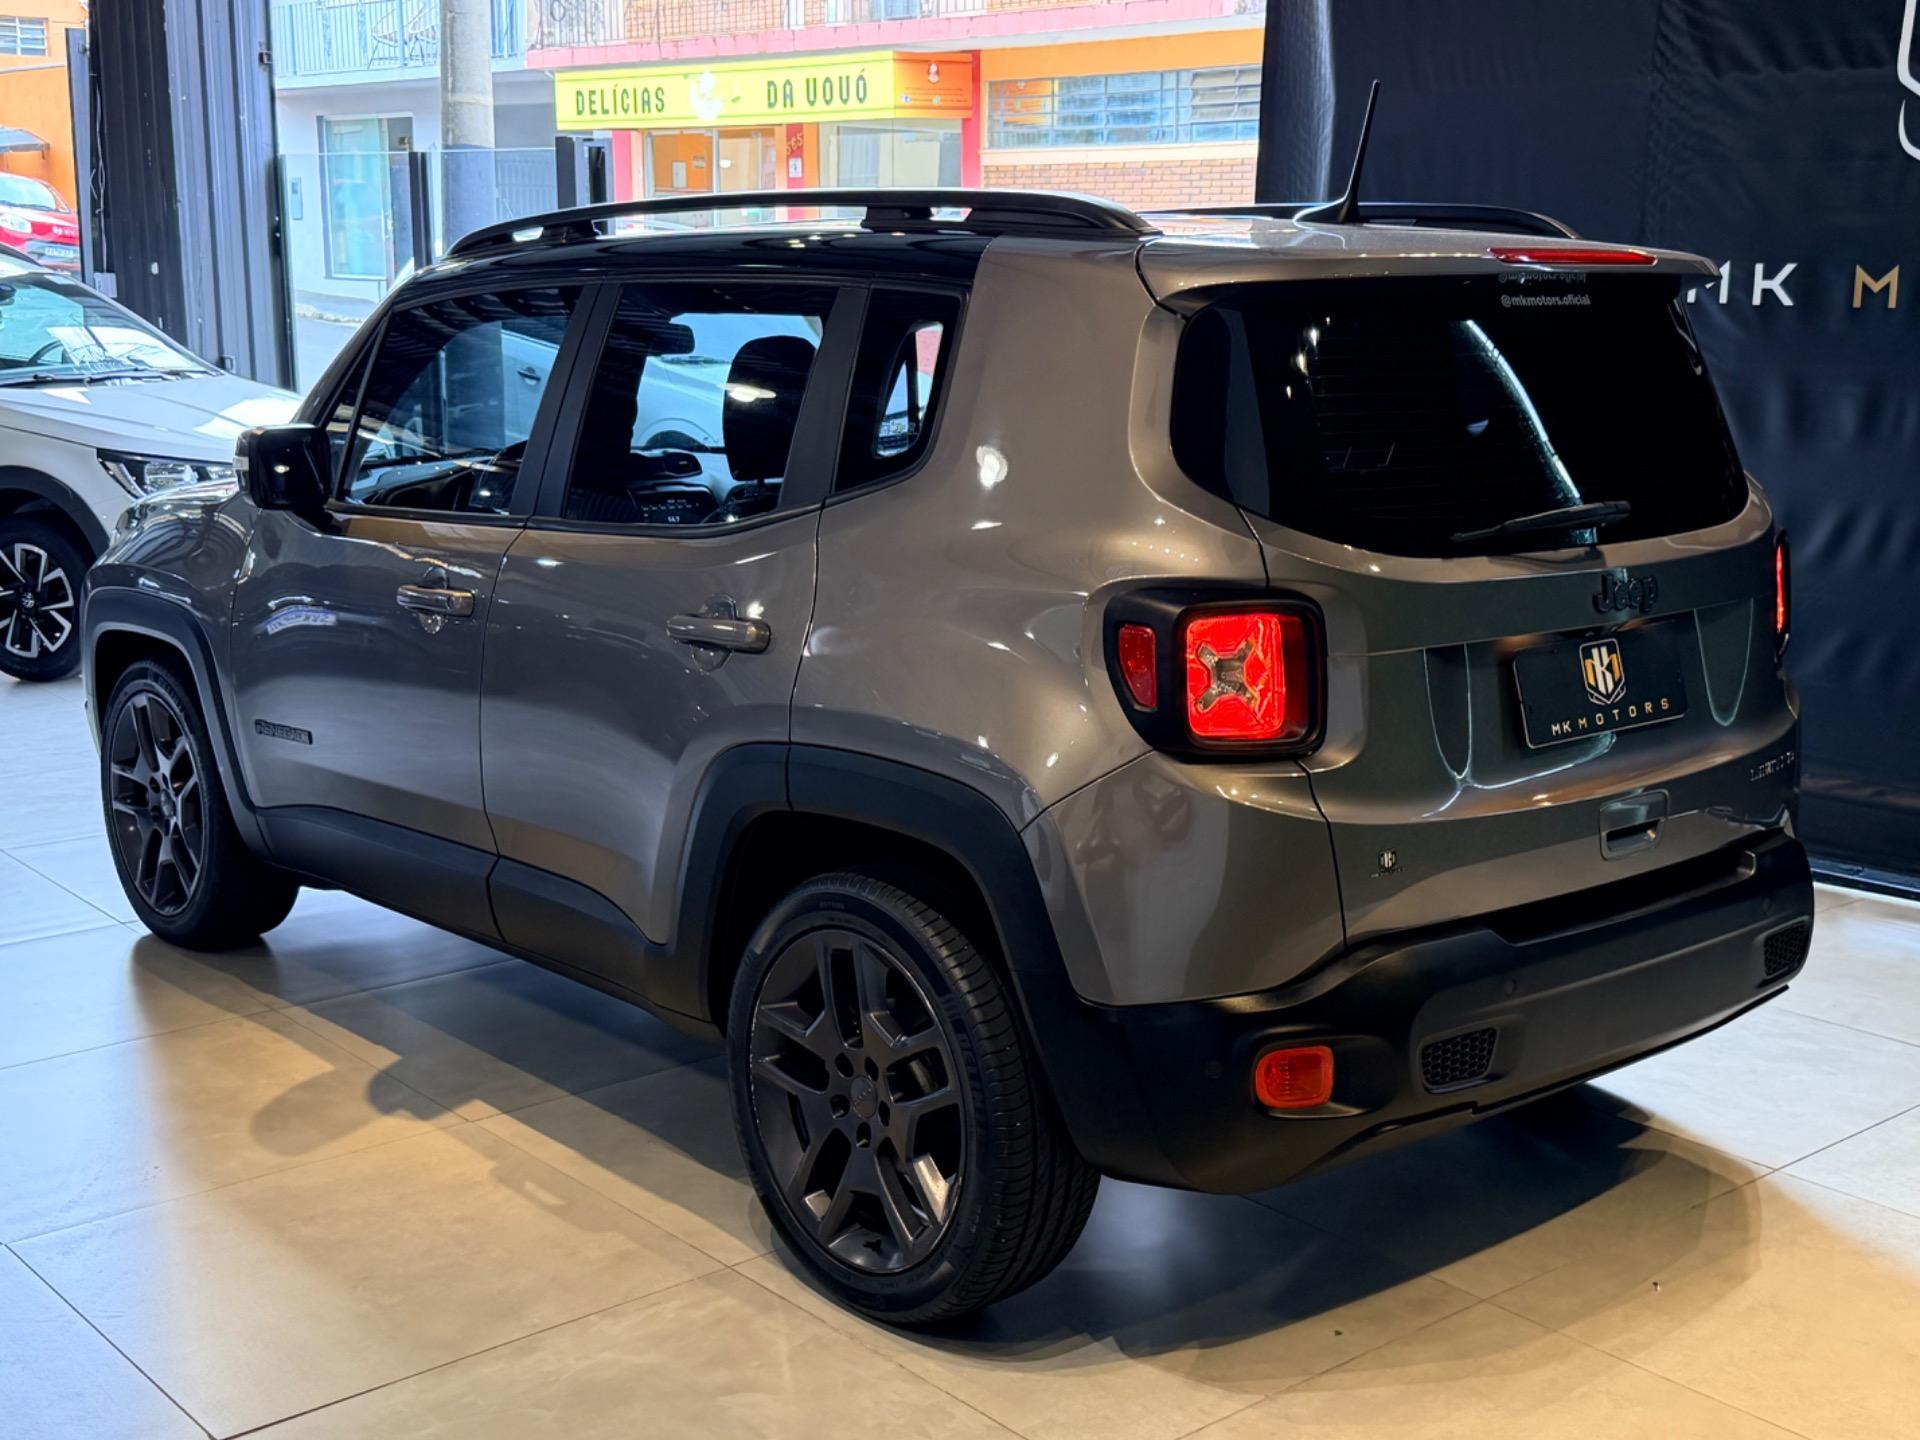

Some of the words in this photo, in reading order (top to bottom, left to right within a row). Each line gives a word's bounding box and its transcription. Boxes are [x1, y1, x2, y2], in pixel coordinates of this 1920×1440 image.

[576, 83, 665, 116] DELÍCIAS
[767, 79, 794, 109] DA
[1592, 572, 1658, 615] Jeep
[1551, 719, 1572, 736] MK
[1577, 698, 1670, 730] MOTORS
